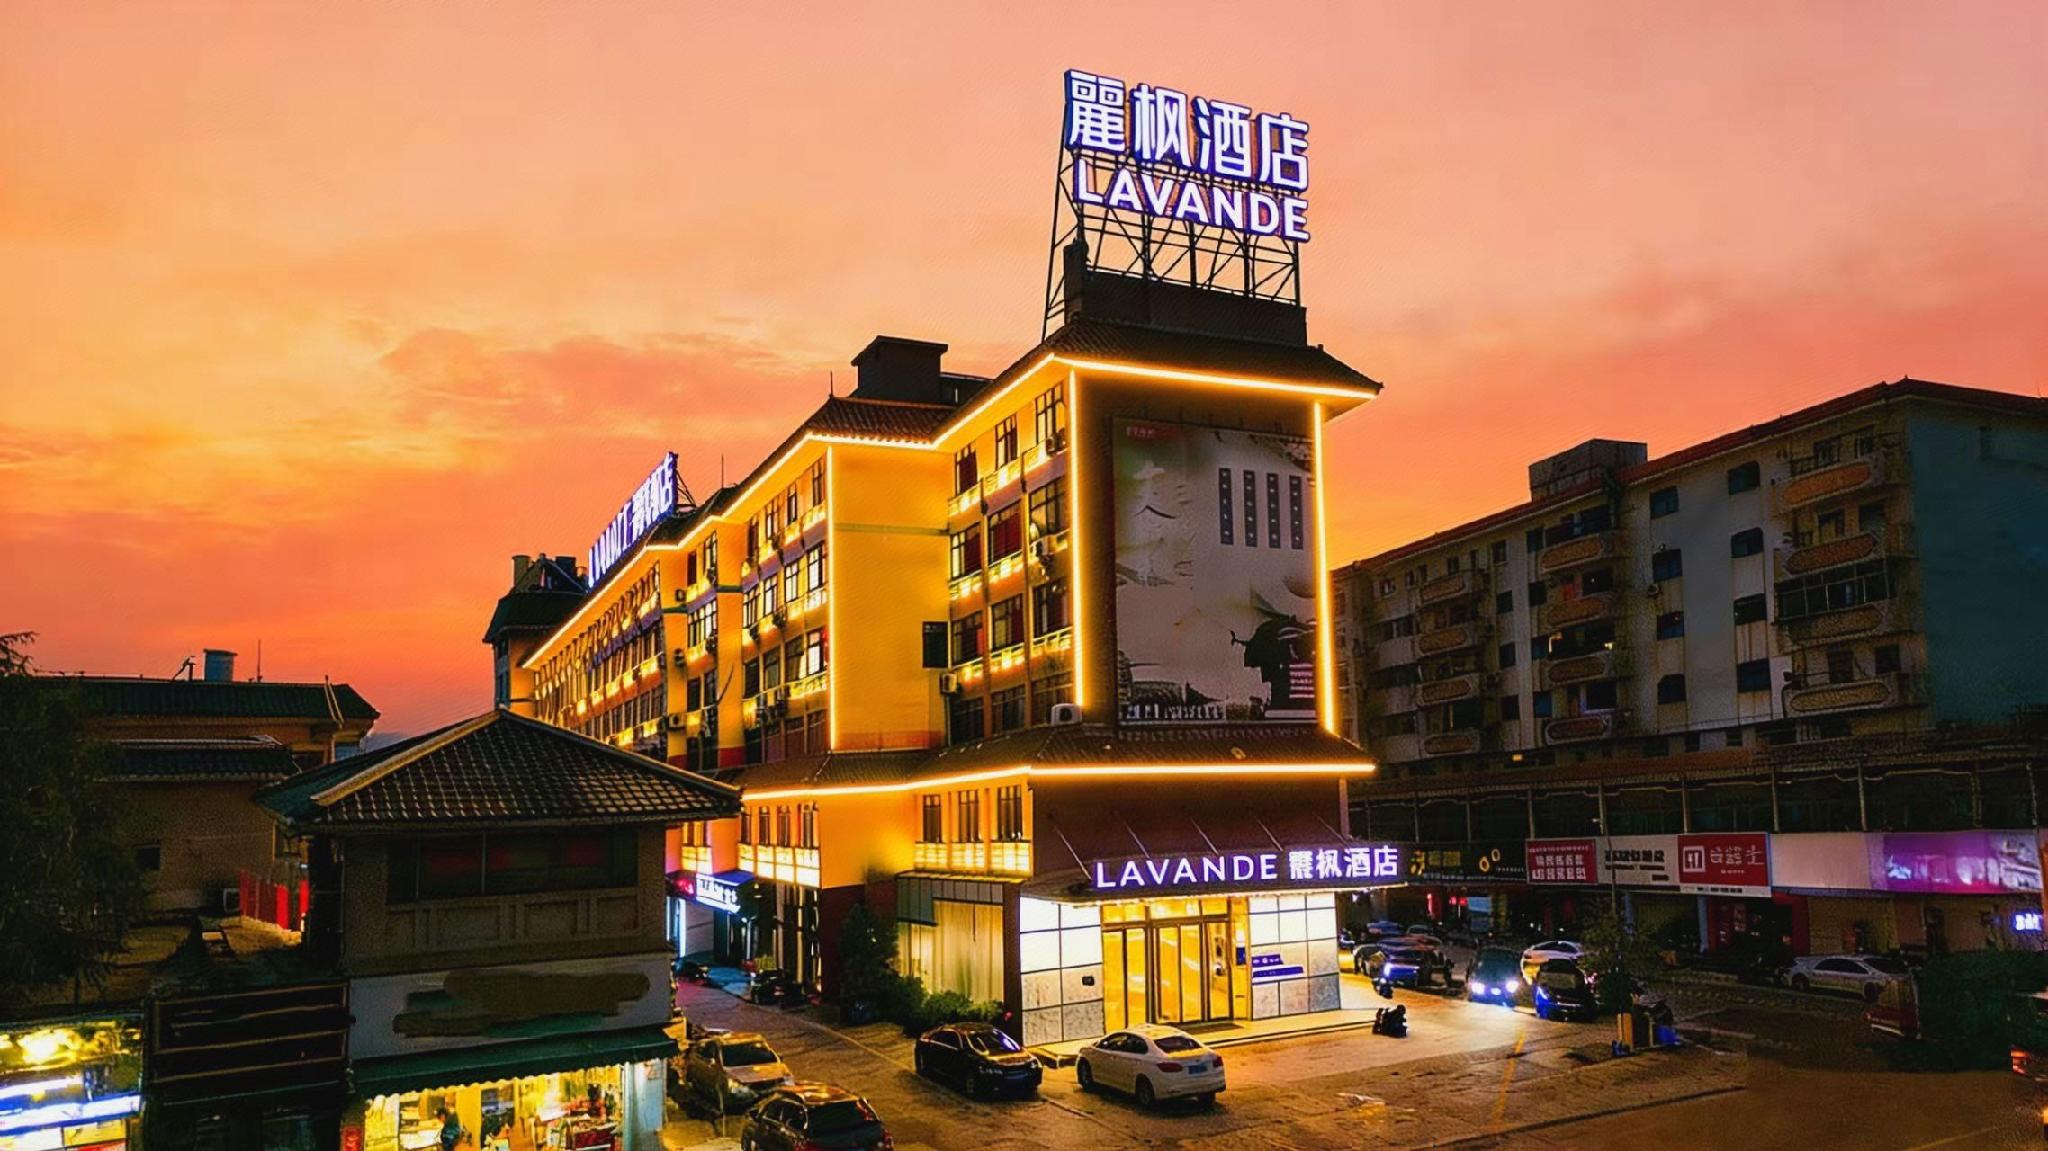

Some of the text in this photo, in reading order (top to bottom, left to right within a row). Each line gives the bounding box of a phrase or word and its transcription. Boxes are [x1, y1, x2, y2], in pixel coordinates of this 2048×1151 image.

[1065, 70, 1309, 191] 麗枫酒店
[1075, 157, 1310, 241] LAVANDE
[1096, 854, 1278, 888] LAVANDE
